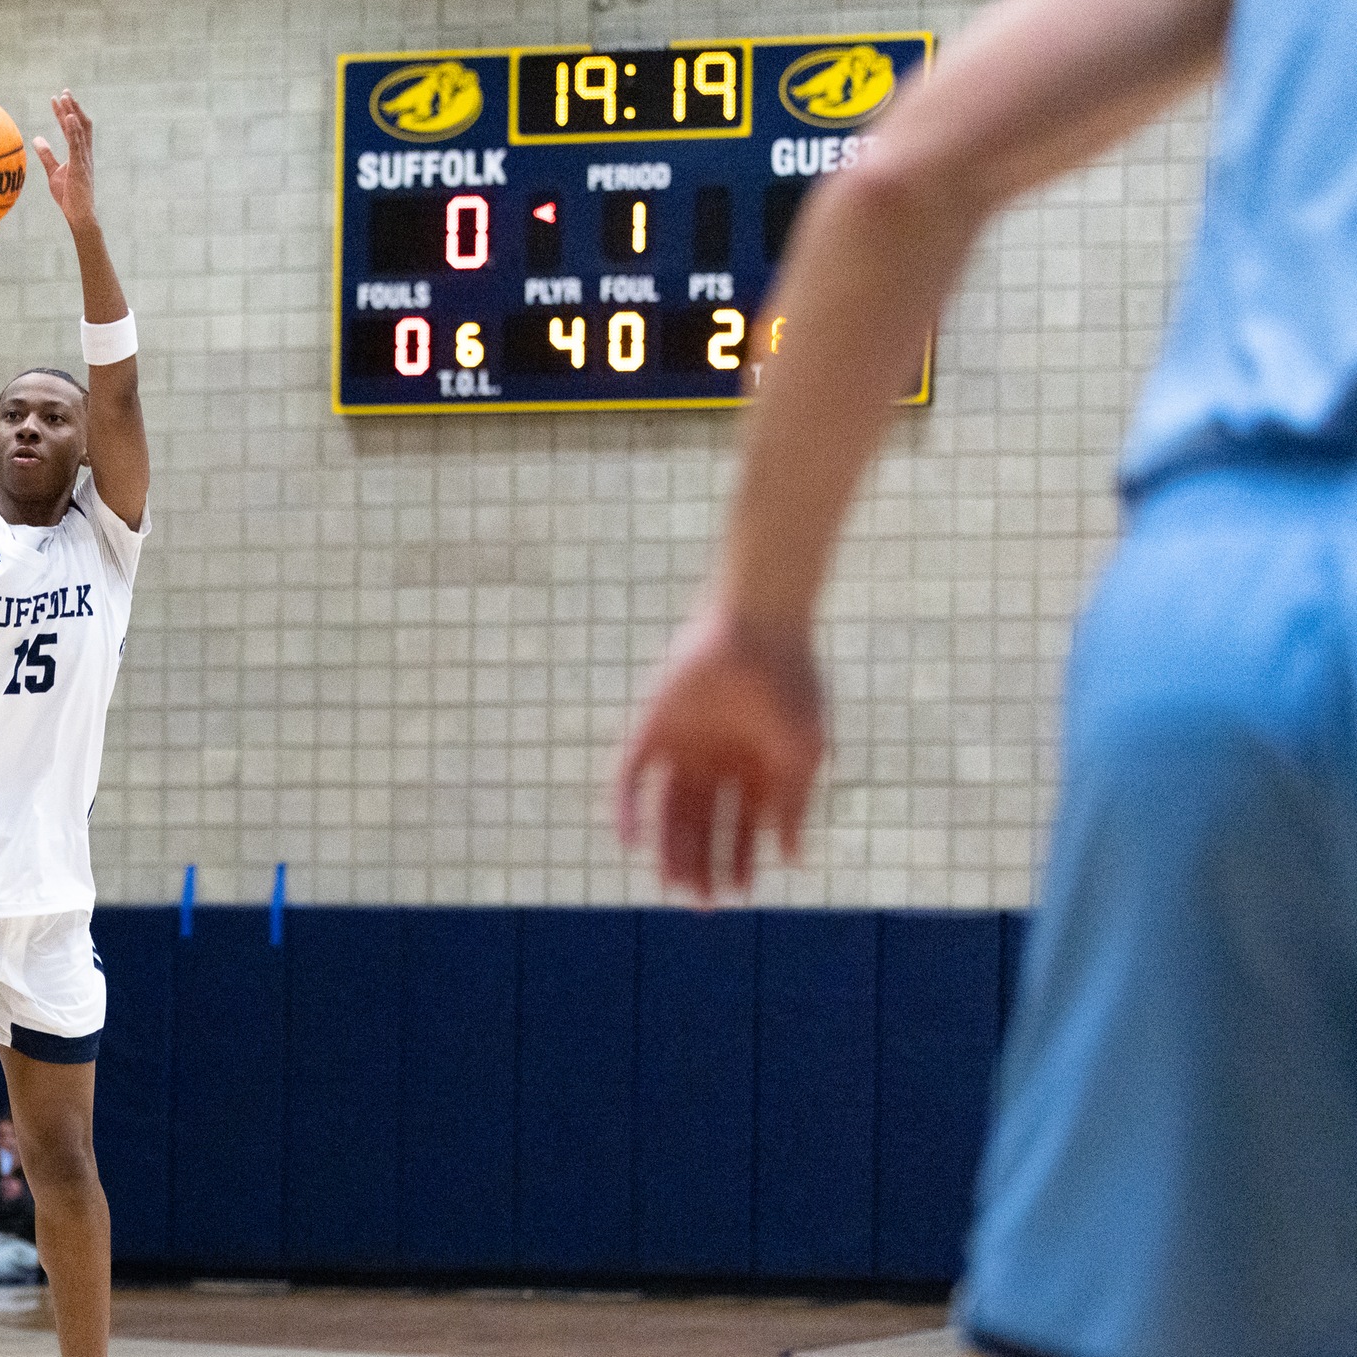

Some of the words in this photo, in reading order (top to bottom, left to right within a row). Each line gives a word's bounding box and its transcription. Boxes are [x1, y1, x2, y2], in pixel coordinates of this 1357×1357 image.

[356, 148, 508, 190] SUFFOLK
[587, 161, 671, 192] PERIOD
[445, 195, 488, 269] 0
[631, 201, 647, 254] 1
[357, 281, 431, 311] FOULS
[524, 276, 583, 306] PLYR
[600, 274, 658, 304] FOUL
[688, 272, 733, 301] PTS
[395, 316, 430, 376] 0
[455, 321, 484, 368] 6
[707, 308, 745, 370] 2
[437, 369, 501, 397] T.O.L.
[3, 632, 58, 695] 15
